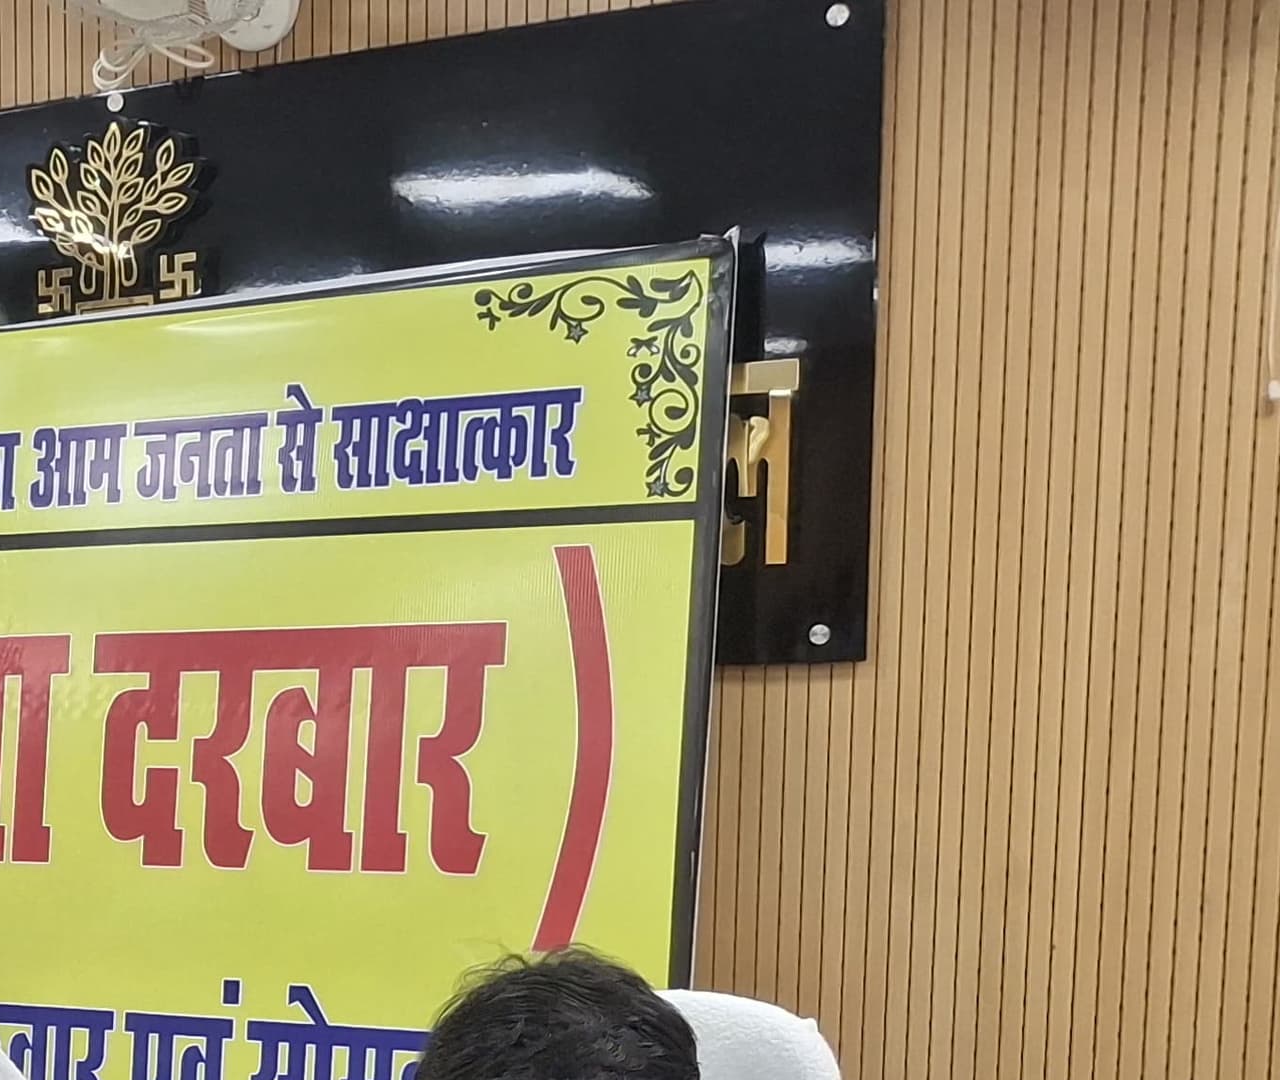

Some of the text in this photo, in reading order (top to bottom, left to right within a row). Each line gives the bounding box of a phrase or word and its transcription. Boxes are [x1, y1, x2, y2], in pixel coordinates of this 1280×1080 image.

[29, 422, 128, 510] आम
[134, 412, 268, 501] जनता
[275, 383, 323, 494] से
[331, 386, 583, 490] साक्षात्कार
